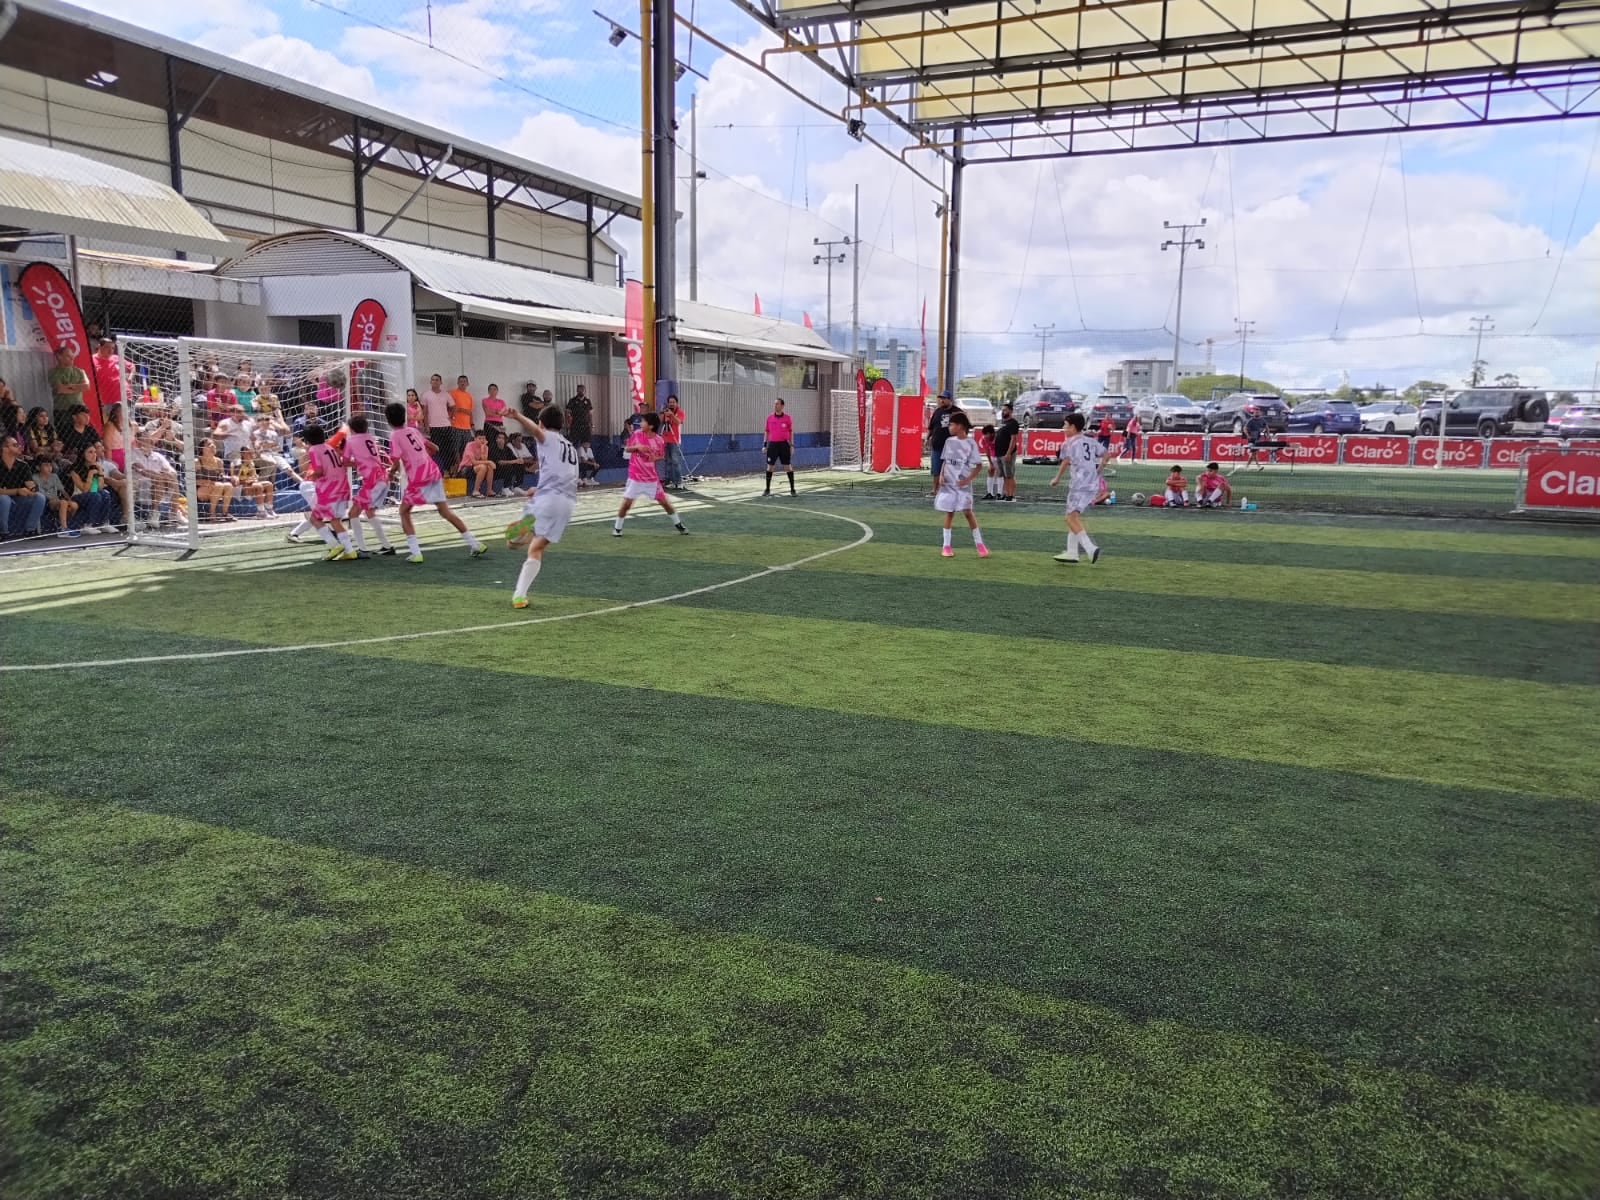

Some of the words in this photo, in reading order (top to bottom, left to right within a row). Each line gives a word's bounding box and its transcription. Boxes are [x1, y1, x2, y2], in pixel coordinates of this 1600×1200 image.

[365, 439, 377, 457] 6
[406, 433, 422, 452] 5
[1033, 438, 1062, 451] Clar
[1152, 442, 1190, 455] Claro
[1083, 442, 1091, 461] 3
[1351, 445, 1394, 459] Claro
